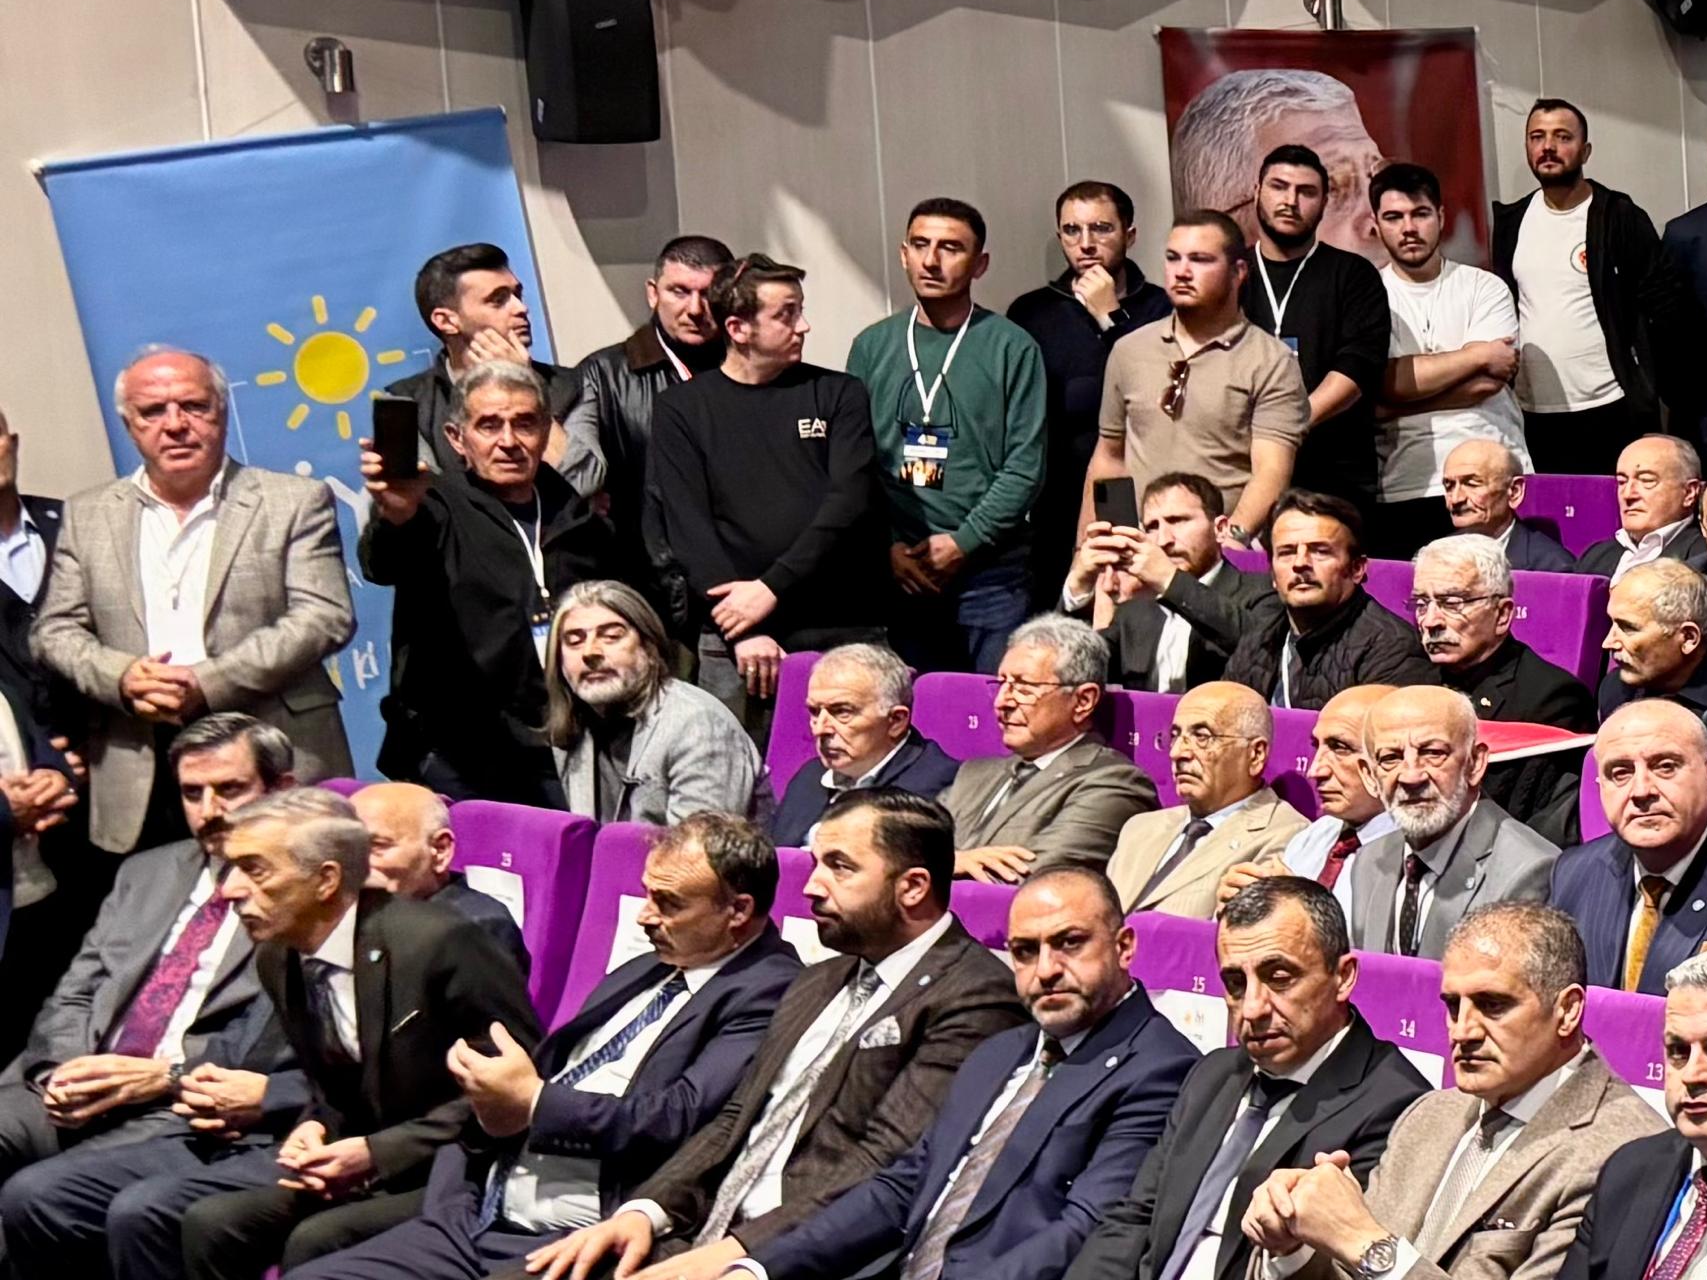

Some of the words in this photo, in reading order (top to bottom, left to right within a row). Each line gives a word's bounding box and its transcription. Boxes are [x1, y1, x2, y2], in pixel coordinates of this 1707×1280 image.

[1516, 606, 1528, 619] 16
[1296, 756, 1308, 772] 17
[1192, 976, 1206, 993] 15
[1399, 1019, 1415, 1039] 14
[1646, 1062, 1664, 1081] 13
